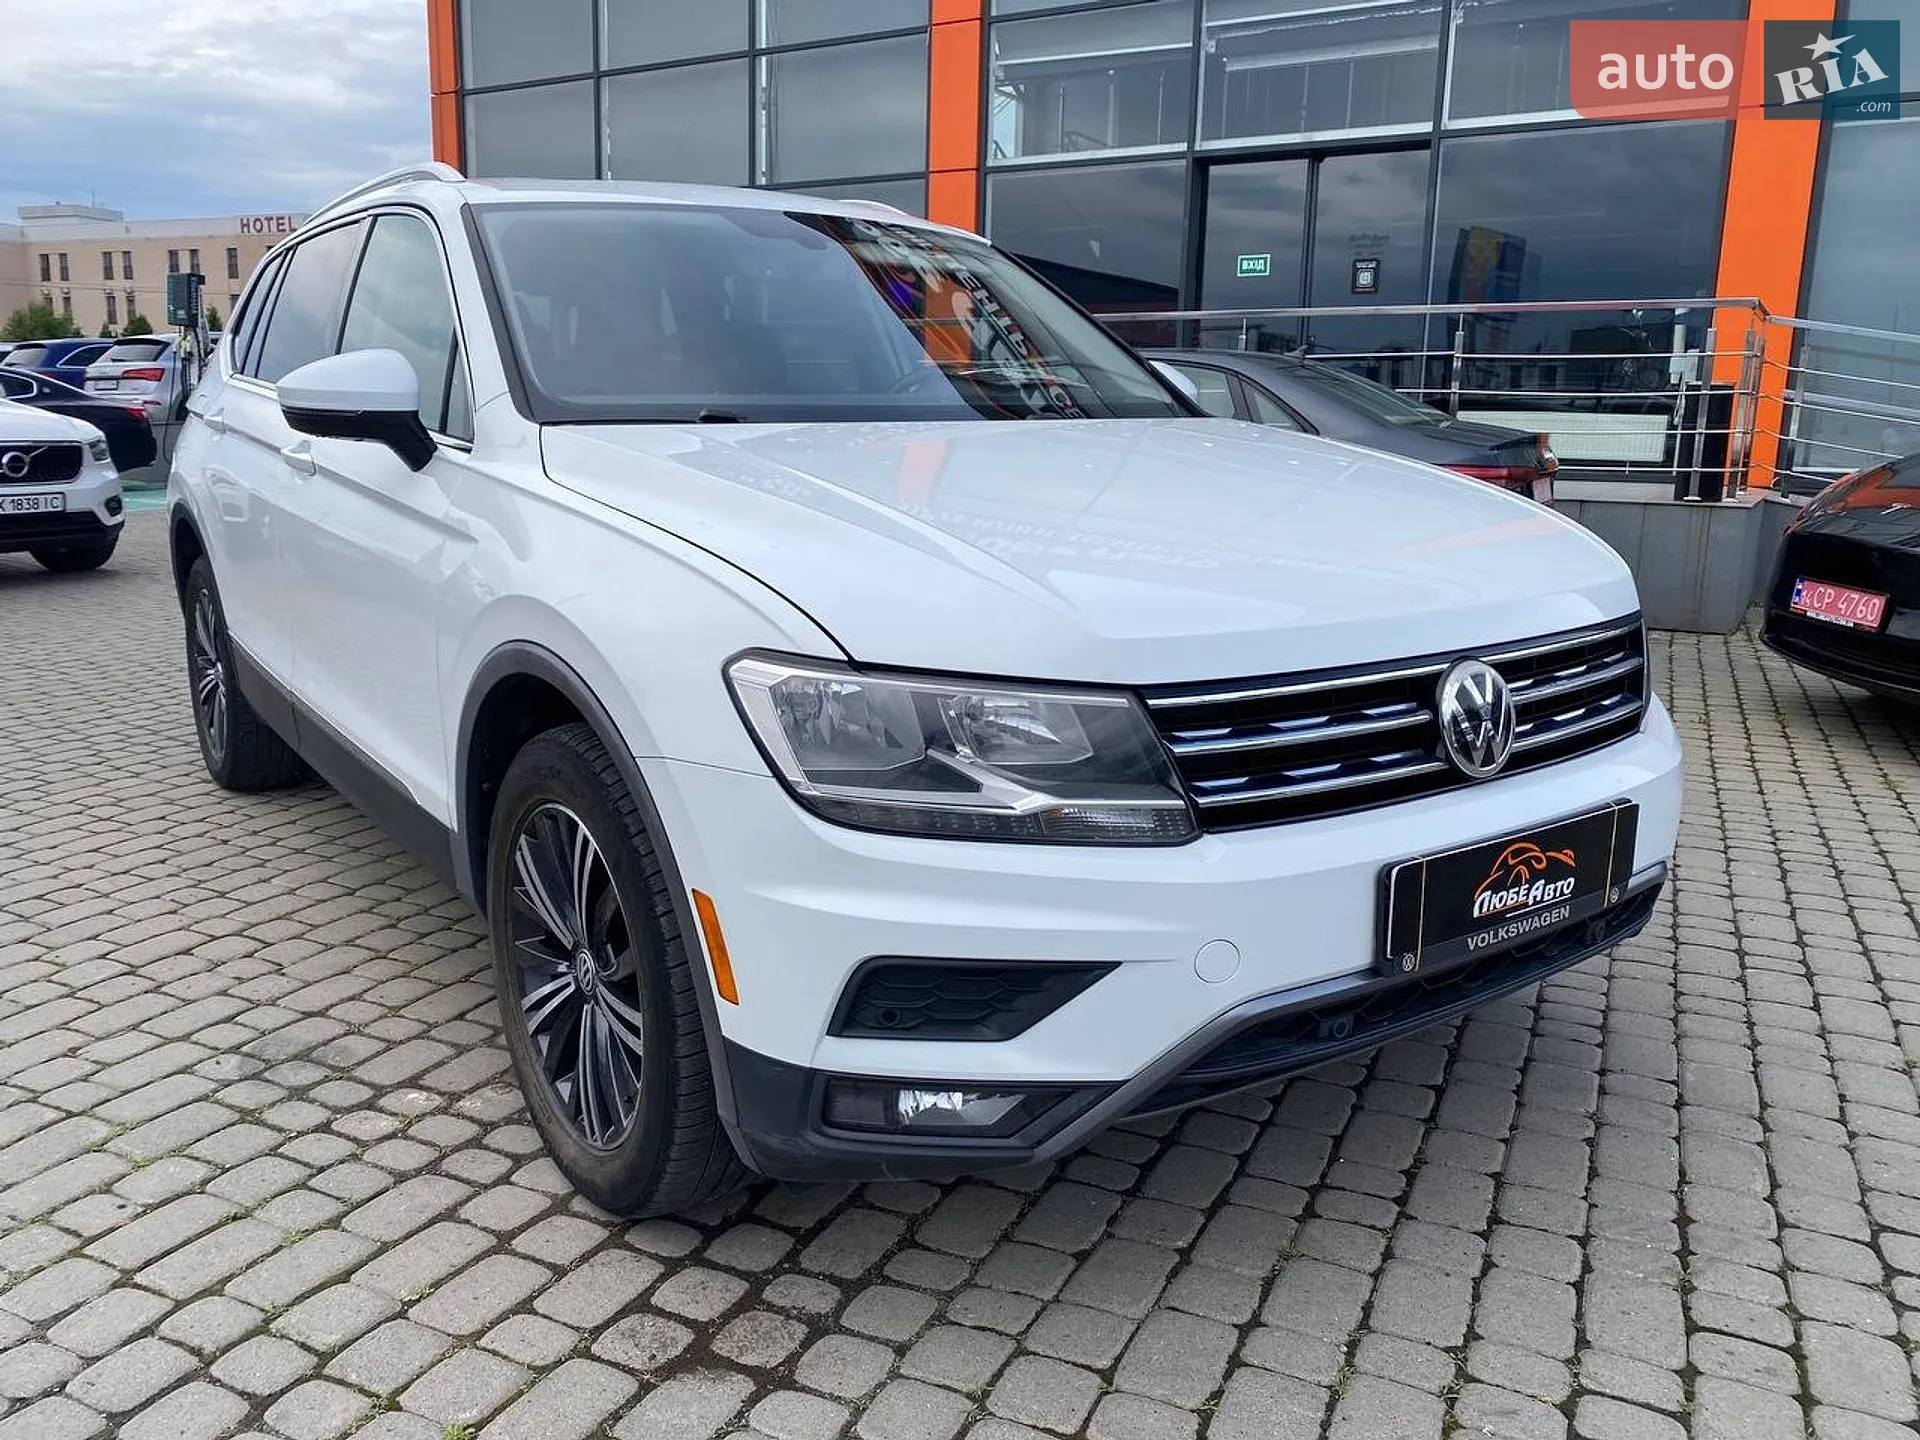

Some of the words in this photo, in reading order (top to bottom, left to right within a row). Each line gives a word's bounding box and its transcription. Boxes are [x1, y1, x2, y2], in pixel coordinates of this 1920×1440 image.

[240, 216, 298, 234] HOTEL
[10, 498, 39, 511] 1838
[1837, 592, 1880, 621] 4760
[1467, 904, 1571, 951] VOLKSWAGEN
